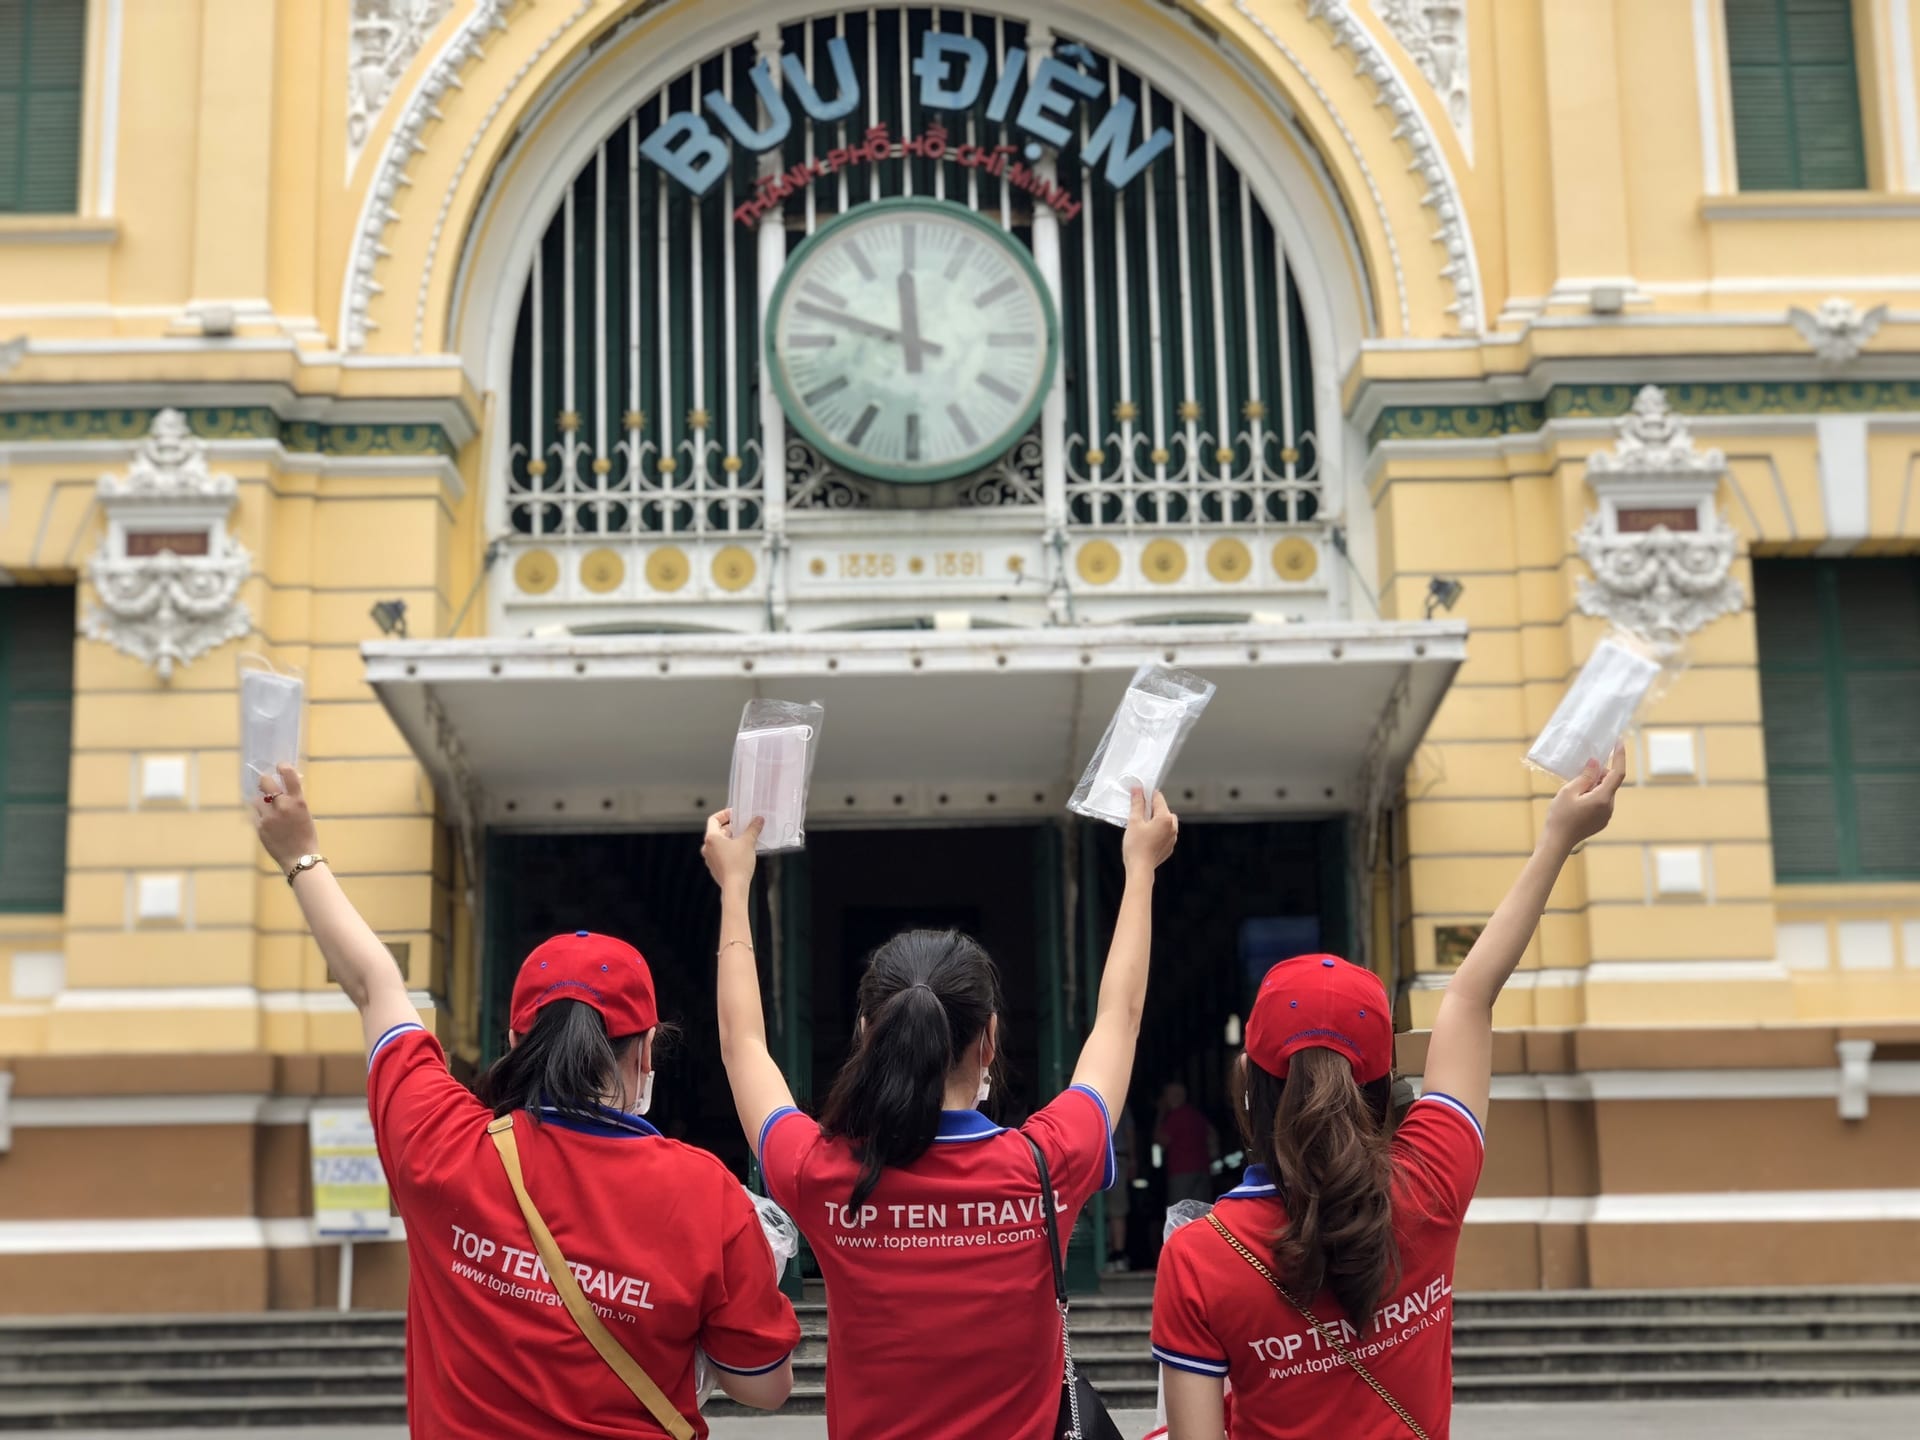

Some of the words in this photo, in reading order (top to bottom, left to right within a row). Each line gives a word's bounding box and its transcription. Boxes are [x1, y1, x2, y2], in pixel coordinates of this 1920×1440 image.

[639, 37, 860, 195] BƯU
[913, 30, 1174, 189] ĐIỆN
[828, 121, 891, 172] PHỐ
[901, 122, 947, 160] HỒ
[957, 143, 1018, 177] CHÍ
[1007, 161, 1083, 220] MINH
[824, 1201, 878, 1229] TOP
[888, 1204, 947, 1229] TEN
[834, 1225, 1049, 1252] www.toptentravel.com.v
[451, 1224, 496, 1264] TOP
[500, 1245, 550, 1284] TEN
[1248, 1333, 1303, 1362] TOP
[1305, 1318, 1358, 1351] TEN
[1373, 1273, 1452, 1333] TRAVEL
